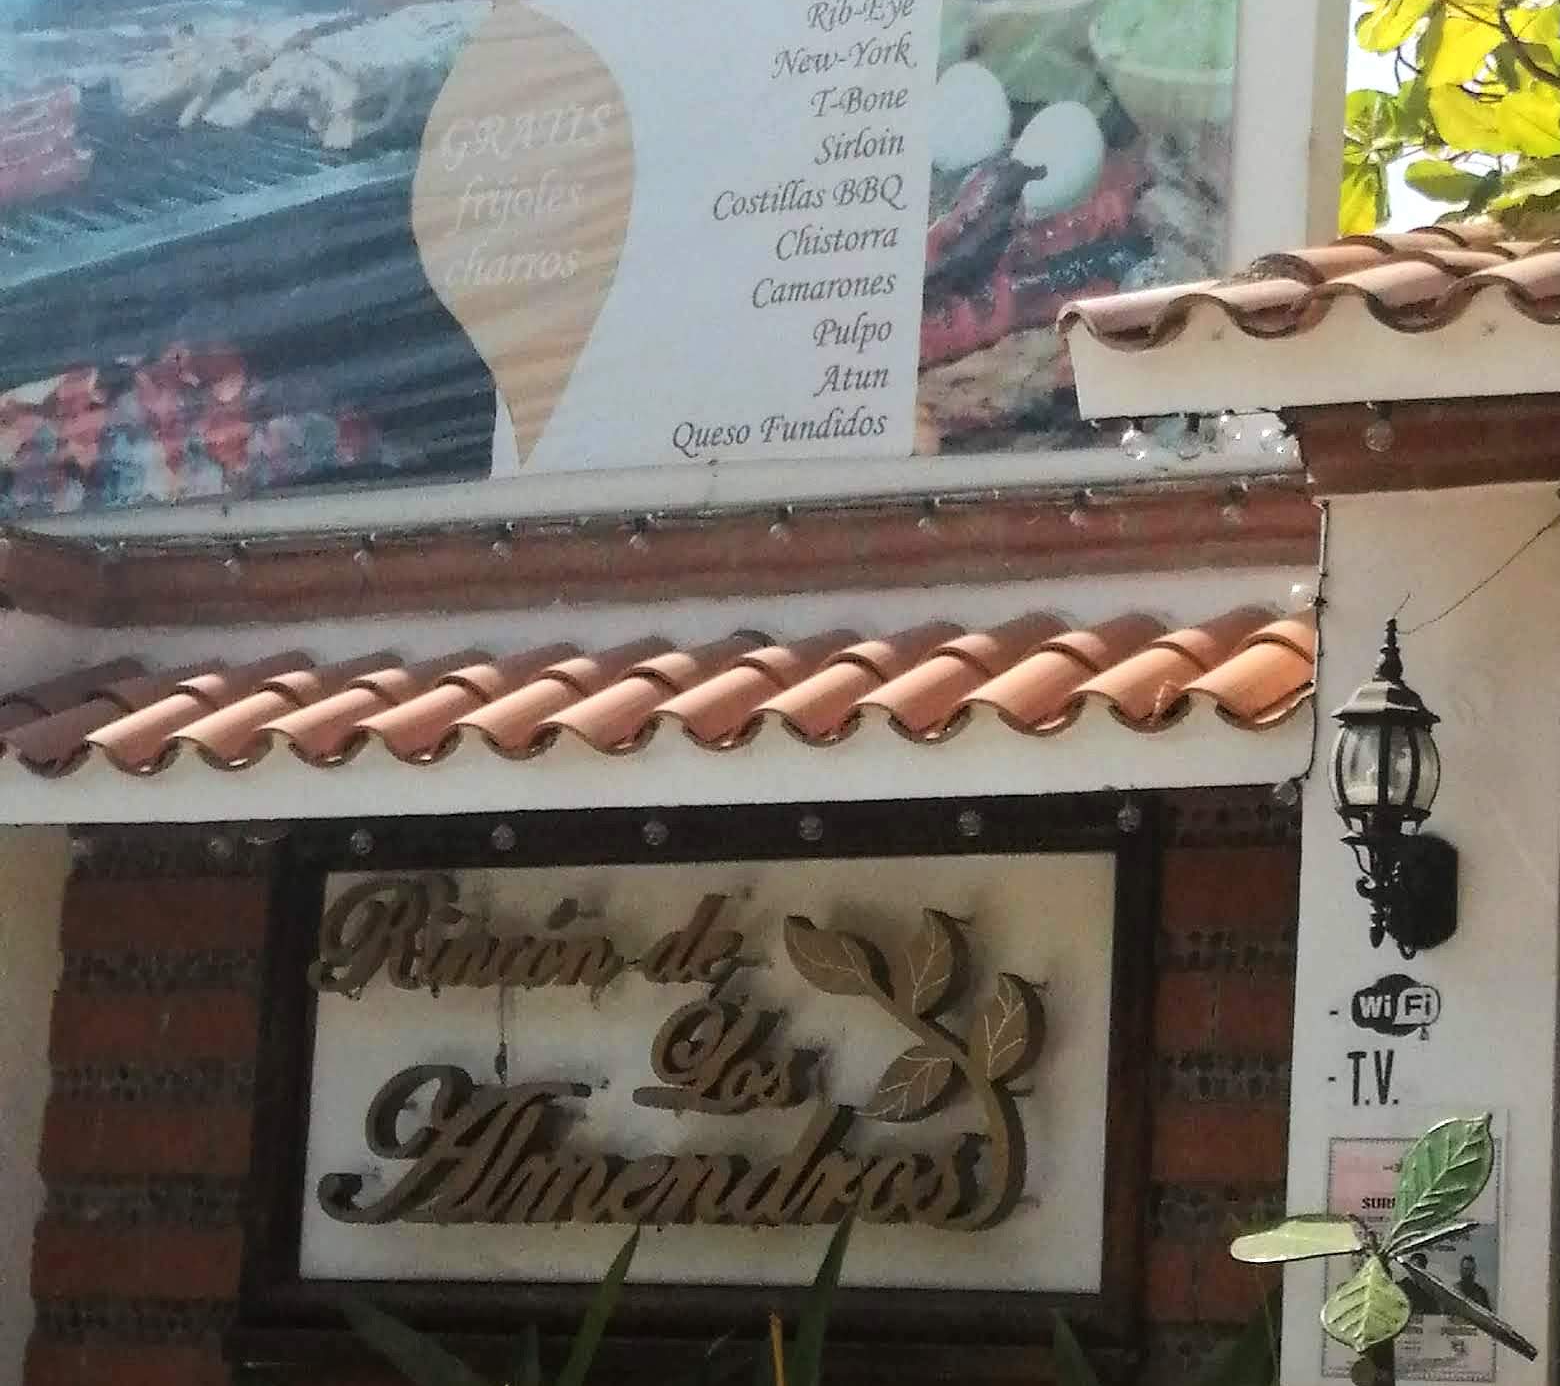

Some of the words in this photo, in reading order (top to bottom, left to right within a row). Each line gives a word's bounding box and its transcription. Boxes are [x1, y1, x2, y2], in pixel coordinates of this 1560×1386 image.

[771, 31, 918, 80] New-York
[810, 86, 909, 117] T-Bone
[440, 102, 611, 173] GRATIS
[814, 126, 904, 165] Sirloin
[713, 178, 826, 221] Costillas
[833, 173, 907, 211] BBQ
[775, 224, 899, 262] Chistorra
[752, 272, 897, 309] Camarones
[813, 311, 893, 354] Pulpo
[813, 363, 889, 398] Atun
[672, 420, 751, 459] Queso
[760, 406, 888, 444] Fundidos
[634, 892, 768, 997] de
[632, 997, 816, 1117] Los
[317, 1063, 1000, 1232] Almendros
